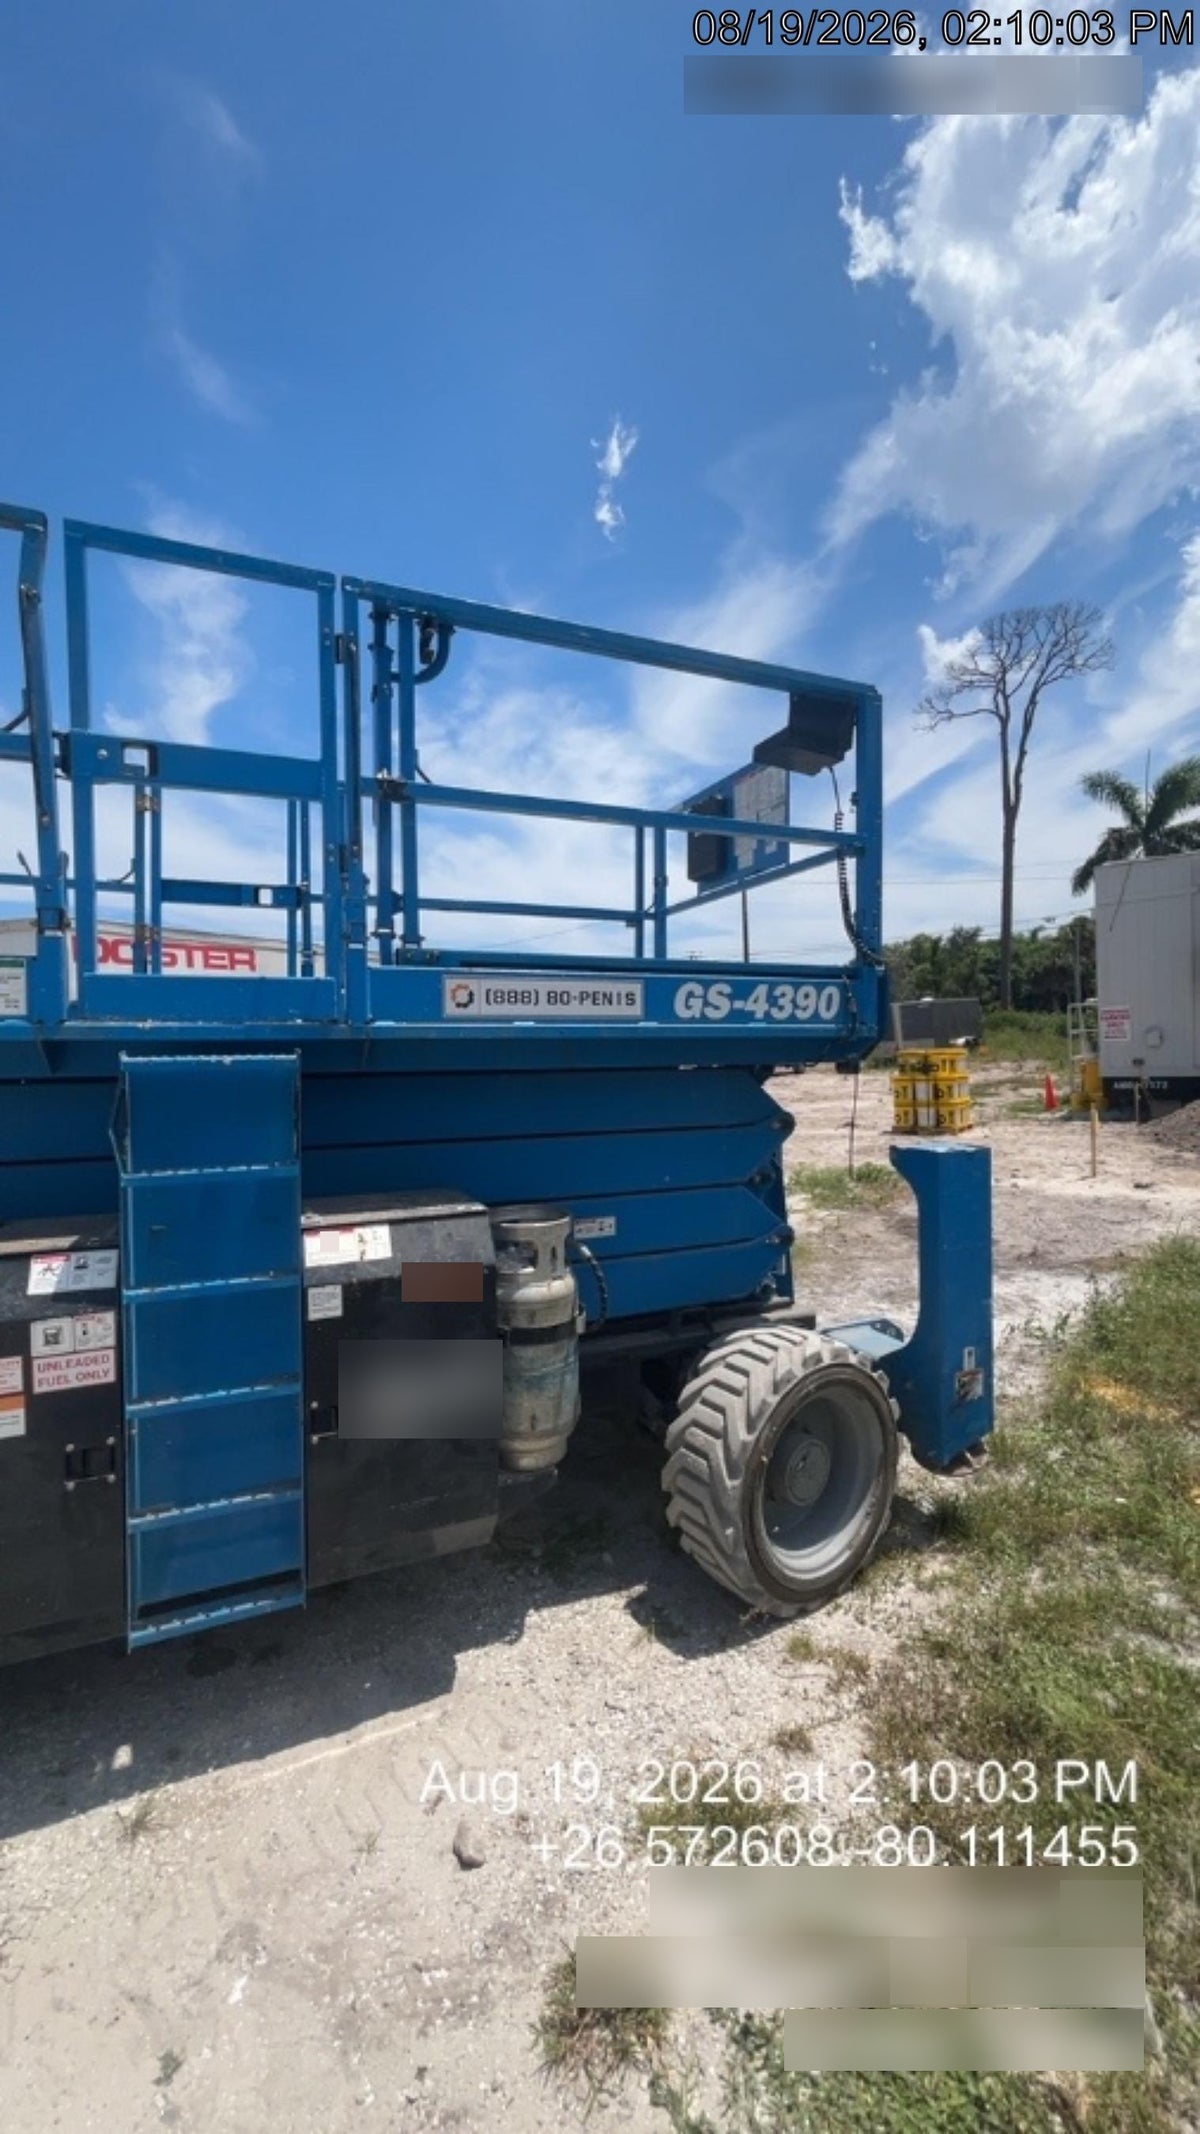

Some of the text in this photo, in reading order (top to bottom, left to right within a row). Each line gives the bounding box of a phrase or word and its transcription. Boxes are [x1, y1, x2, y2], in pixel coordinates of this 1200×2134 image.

[485, 988, 539, 1007] (888)
[673, 981, 840, 1020] GS-4390
[37, 1353, 110, 1373] UNLEADED
[37, 1374, 71, 1388] FUEL
[75, 1367, 110, 1383] ONLY
